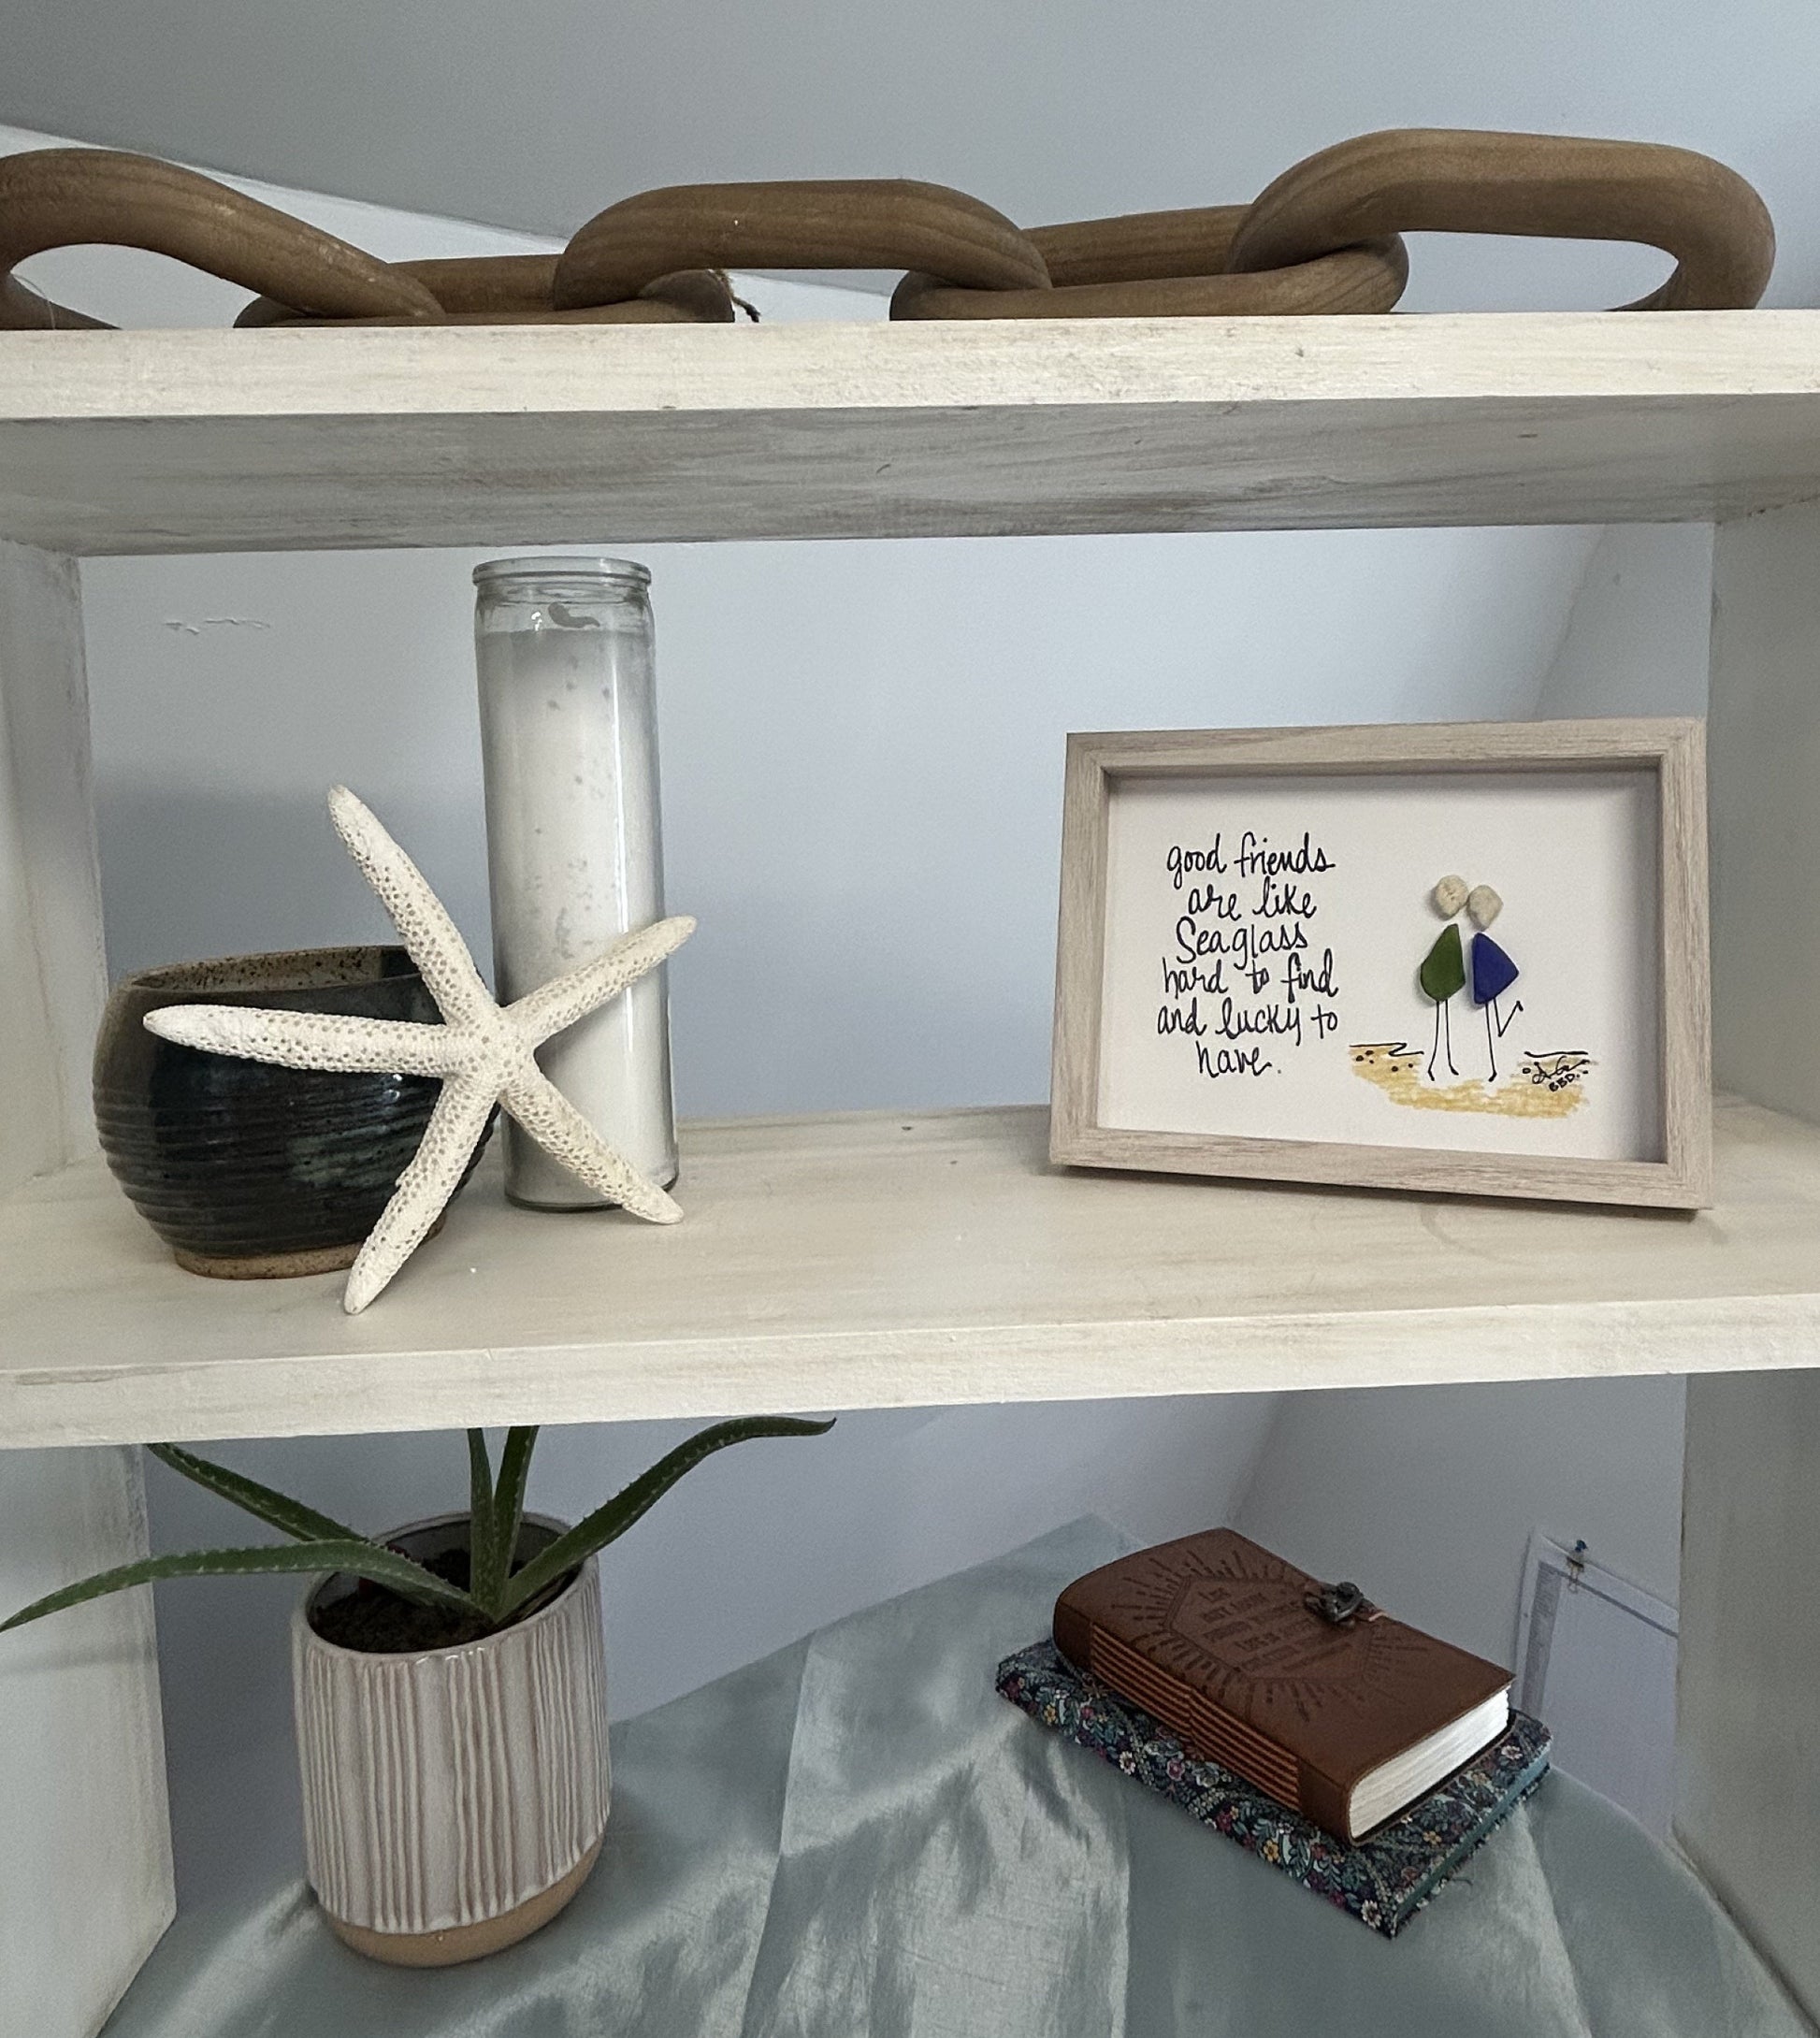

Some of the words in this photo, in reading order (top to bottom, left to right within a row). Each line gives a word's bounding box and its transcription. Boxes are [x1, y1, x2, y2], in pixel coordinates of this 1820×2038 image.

[1166, 832, 1228, 890] good
[1233, 831, 1336, 878] friends
[1188, 883, 1242, 922] are
[1251, 874, 1318, 919] like
[1176, 915, 1308, 971] Seaglass
[1162, 956, 1229, 1000] hard
[1245, 959, 1270, 995] to
[1279, 947, 1339, 1005] find
[1157, 996, 1207, 1036] and
[1214, 996, 1302, 1047] lucky
[1310, 1004, 1338, 1040] to
